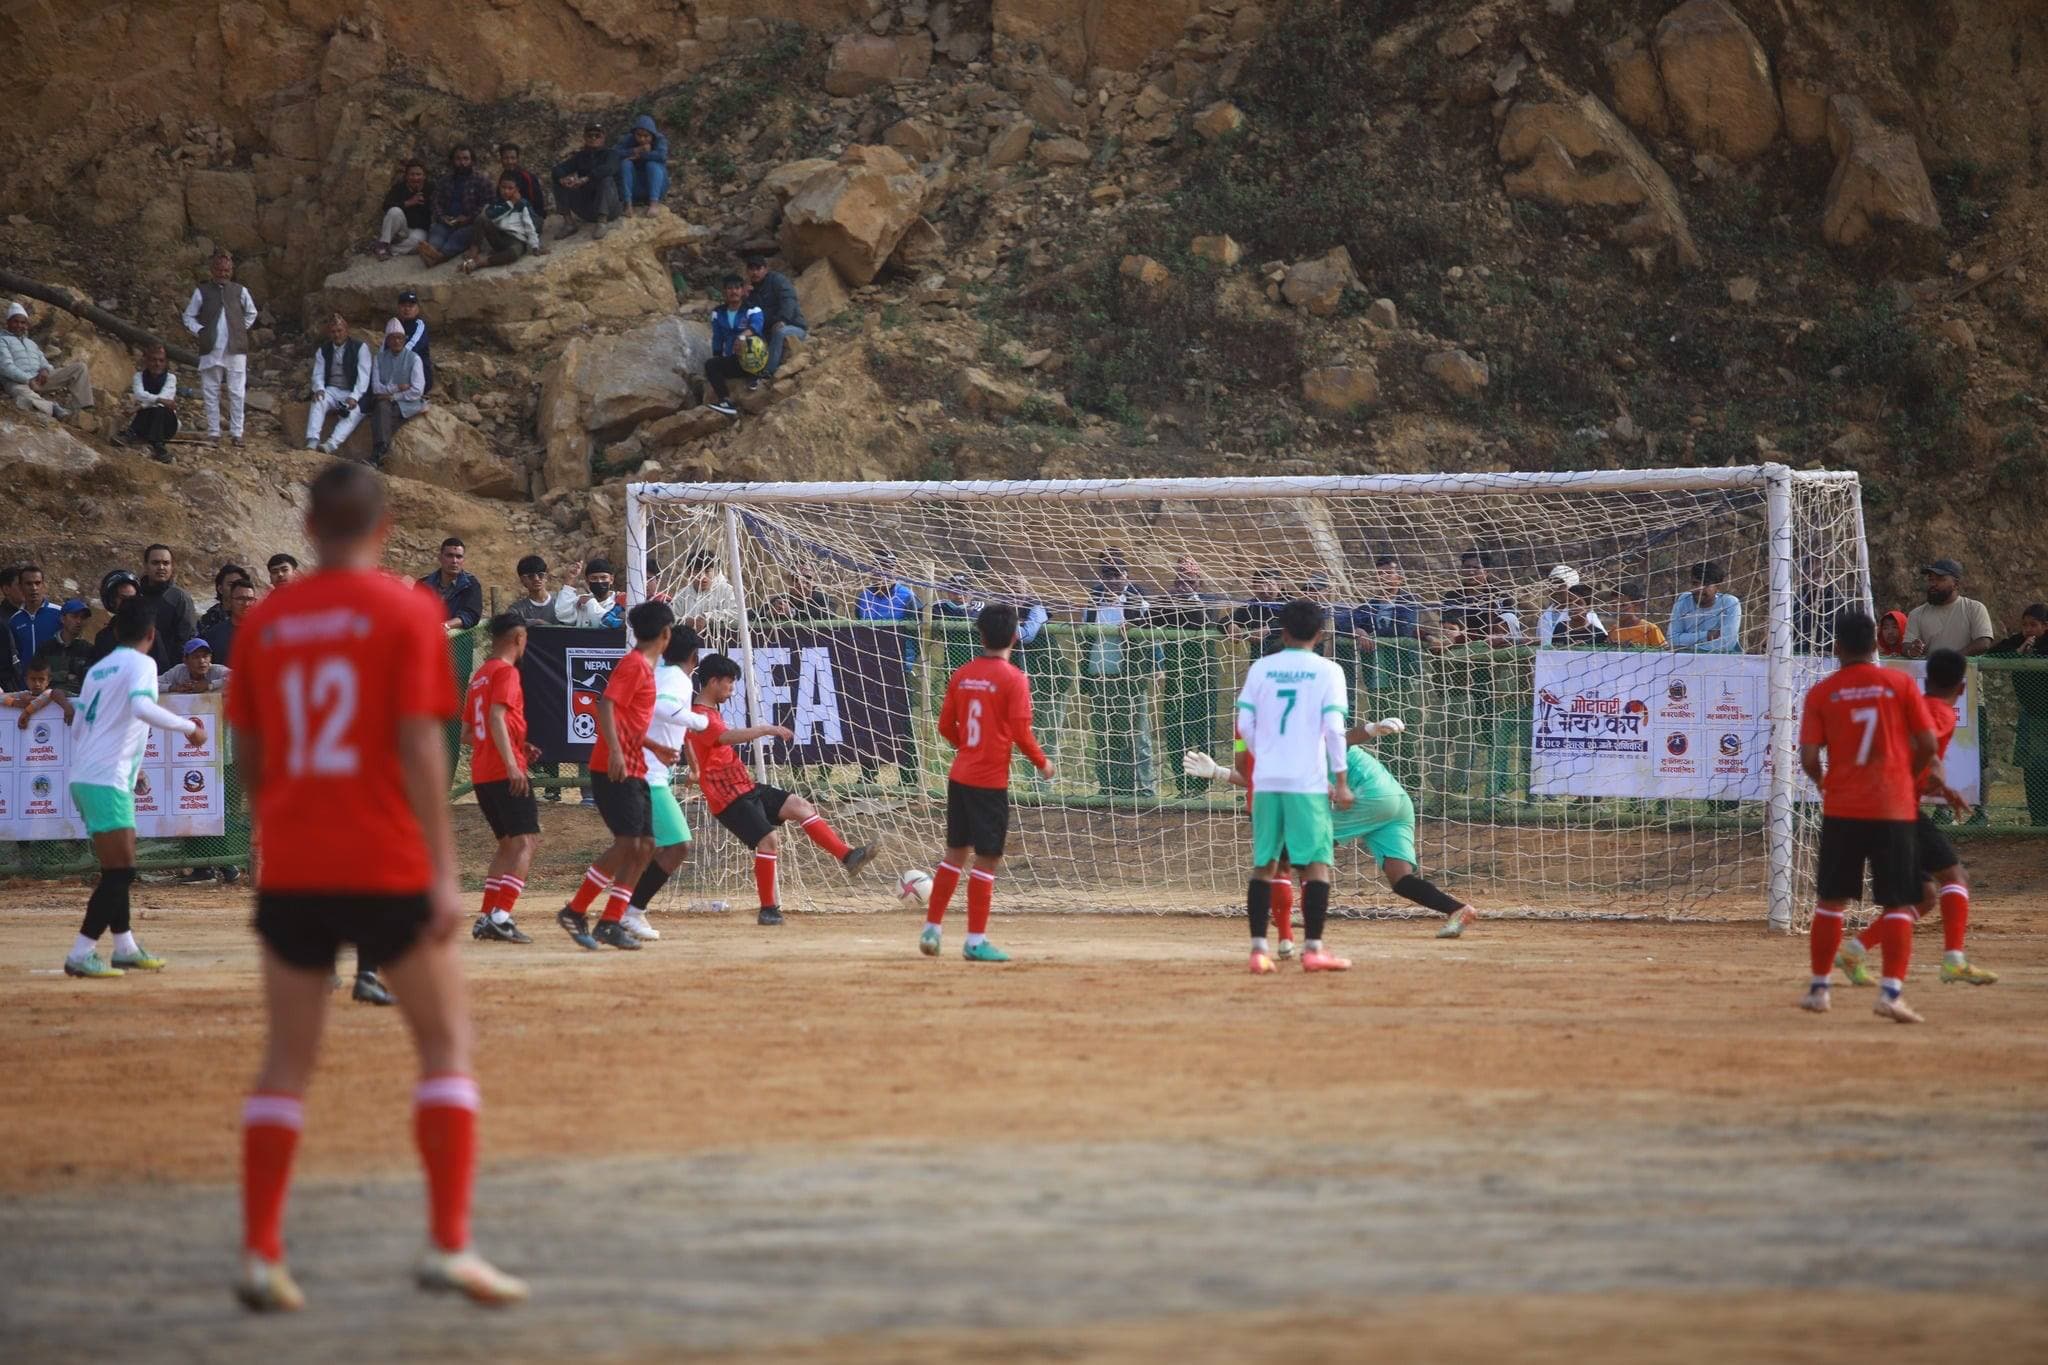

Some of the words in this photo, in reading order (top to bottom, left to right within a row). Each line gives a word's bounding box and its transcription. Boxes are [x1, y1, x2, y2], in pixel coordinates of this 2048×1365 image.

[584, 661, 612, 671] NEPAL
[1266, 671, 1317, 680] MAHALAXMI
[84, 688, 101, 728] 4
[281, 657, 360, 777] 12
[474, 694, 486, 740] 5
[966, 699, 982, 748] 6
[1277, 689, 1297, 735] 7
[1571, 695, 1620, 714] गोदावरी
[1604, 714, 1641, 735] कप
[1851, 707, 1879, 766] 7
